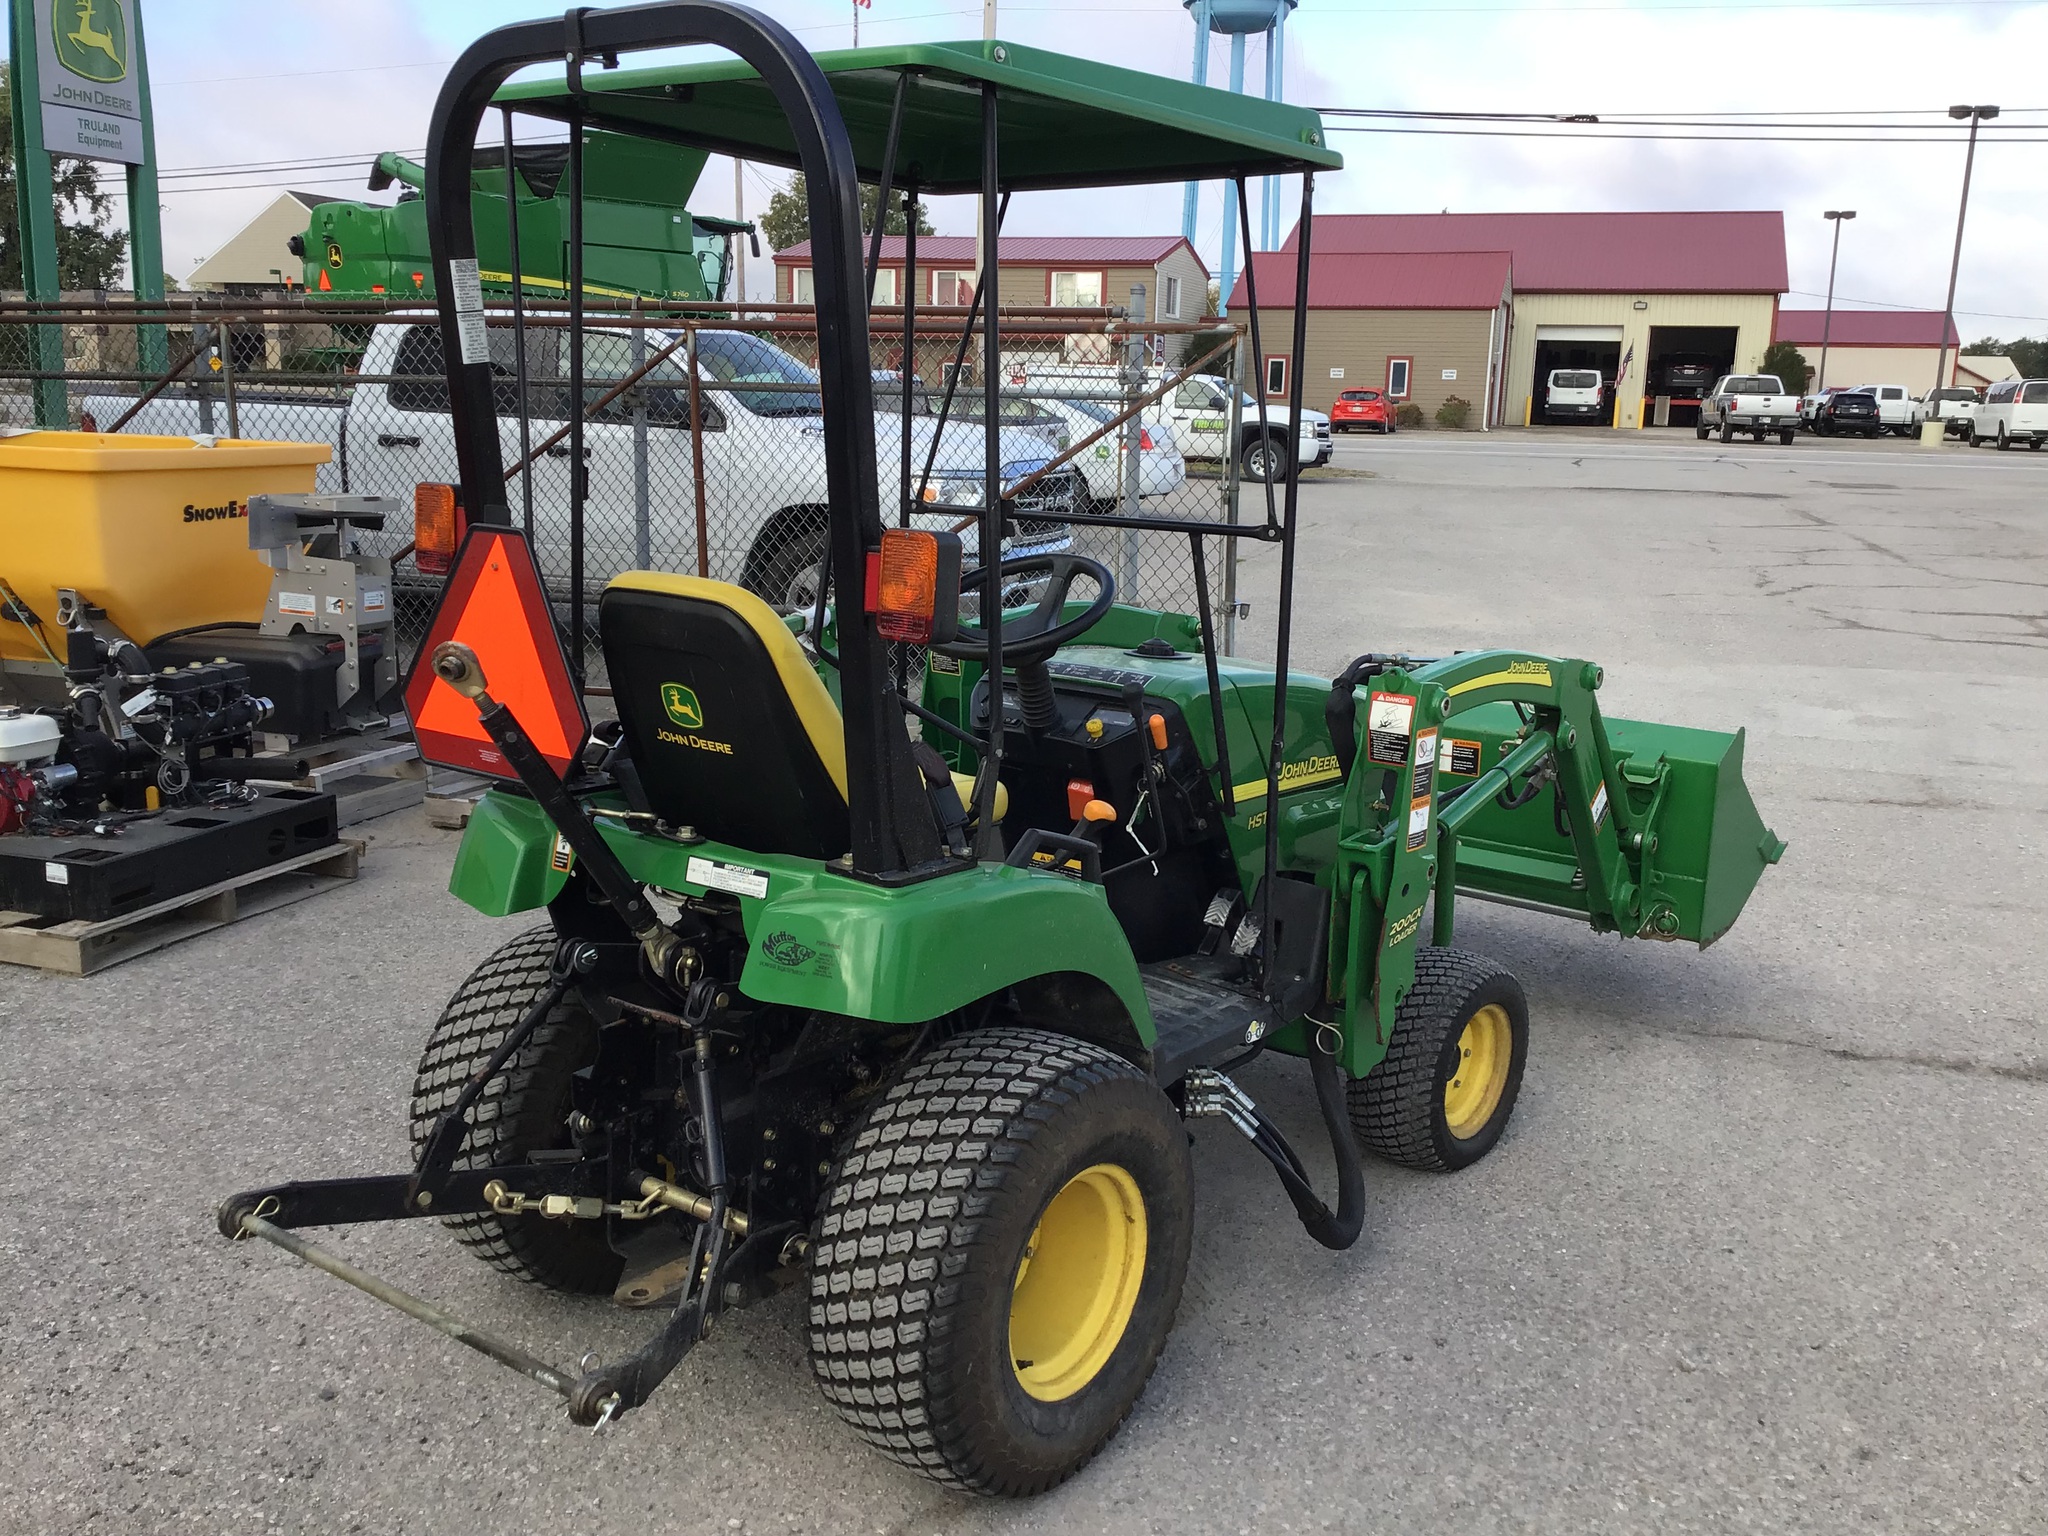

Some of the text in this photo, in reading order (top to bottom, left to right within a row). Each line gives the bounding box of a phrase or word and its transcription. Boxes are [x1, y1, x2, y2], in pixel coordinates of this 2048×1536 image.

[53, 84, 132, 112] JOHN DEERE
[77, 117, 121, 136] TRULAND
[77, 132, 123, 150] Equipment
[1507, 660, 1549, 674] JOHN DEERE
[1385, 695, 1410, 705] DANGER
[656, 727, 734, 755] JOHN DEERE
[1278, 755, 1340, 781] JOHN DEER
[1247, 811, 1268, 831] HST
[724, 863, 756, 876] IMPORTANT
[762, 930, 797, 958] Mutton
[1389, 921, 1418, 948] LOADER
